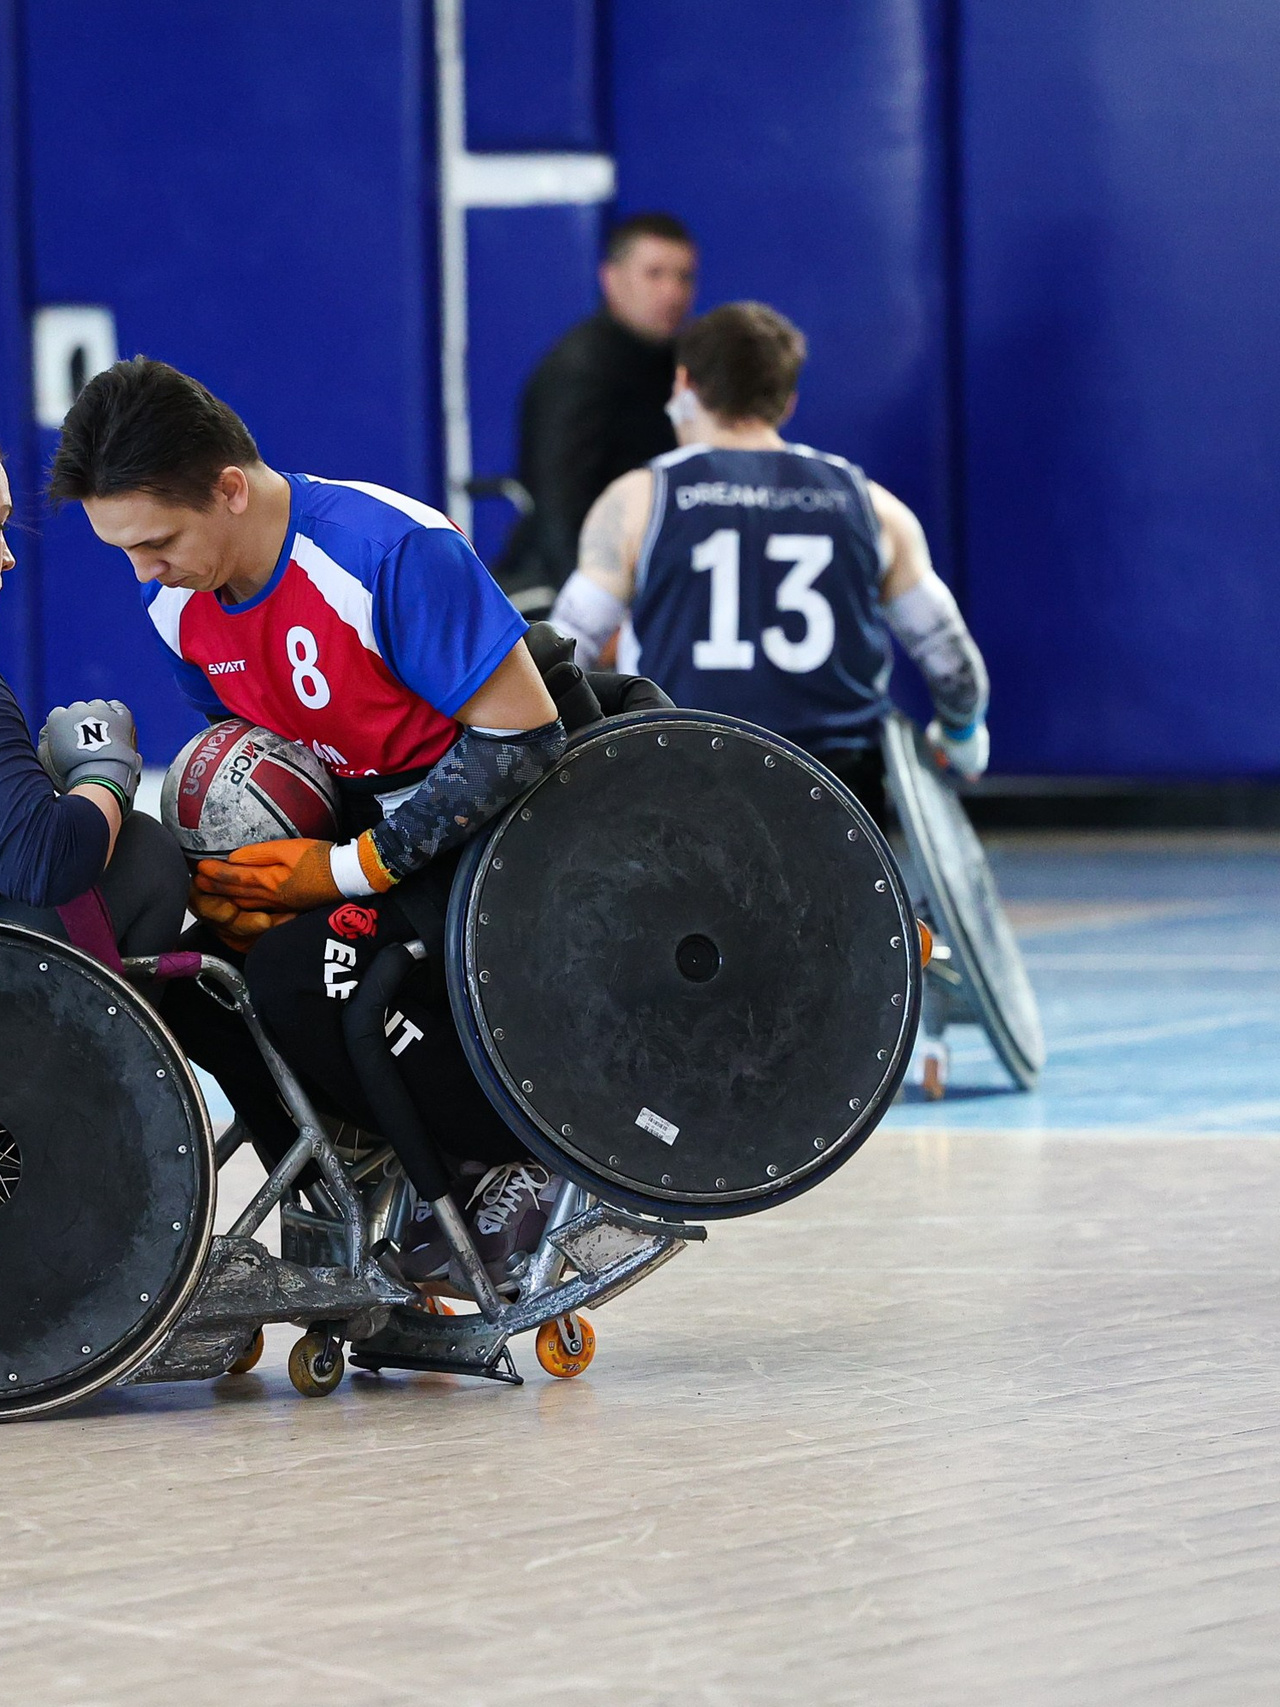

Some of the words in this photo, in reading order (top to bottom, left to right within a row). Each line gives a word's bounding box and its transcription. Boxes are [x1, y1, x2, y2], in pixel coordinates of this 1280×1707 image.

[676, 482, 847, 513] DREAMSPORT
[691, 528, 835, 674] 13
[208, 659, 246, 675] SVART
[285, 625, 332, 710] 8
[81, 722, 105, 746] N
[183, 721, 241, 795] molten
